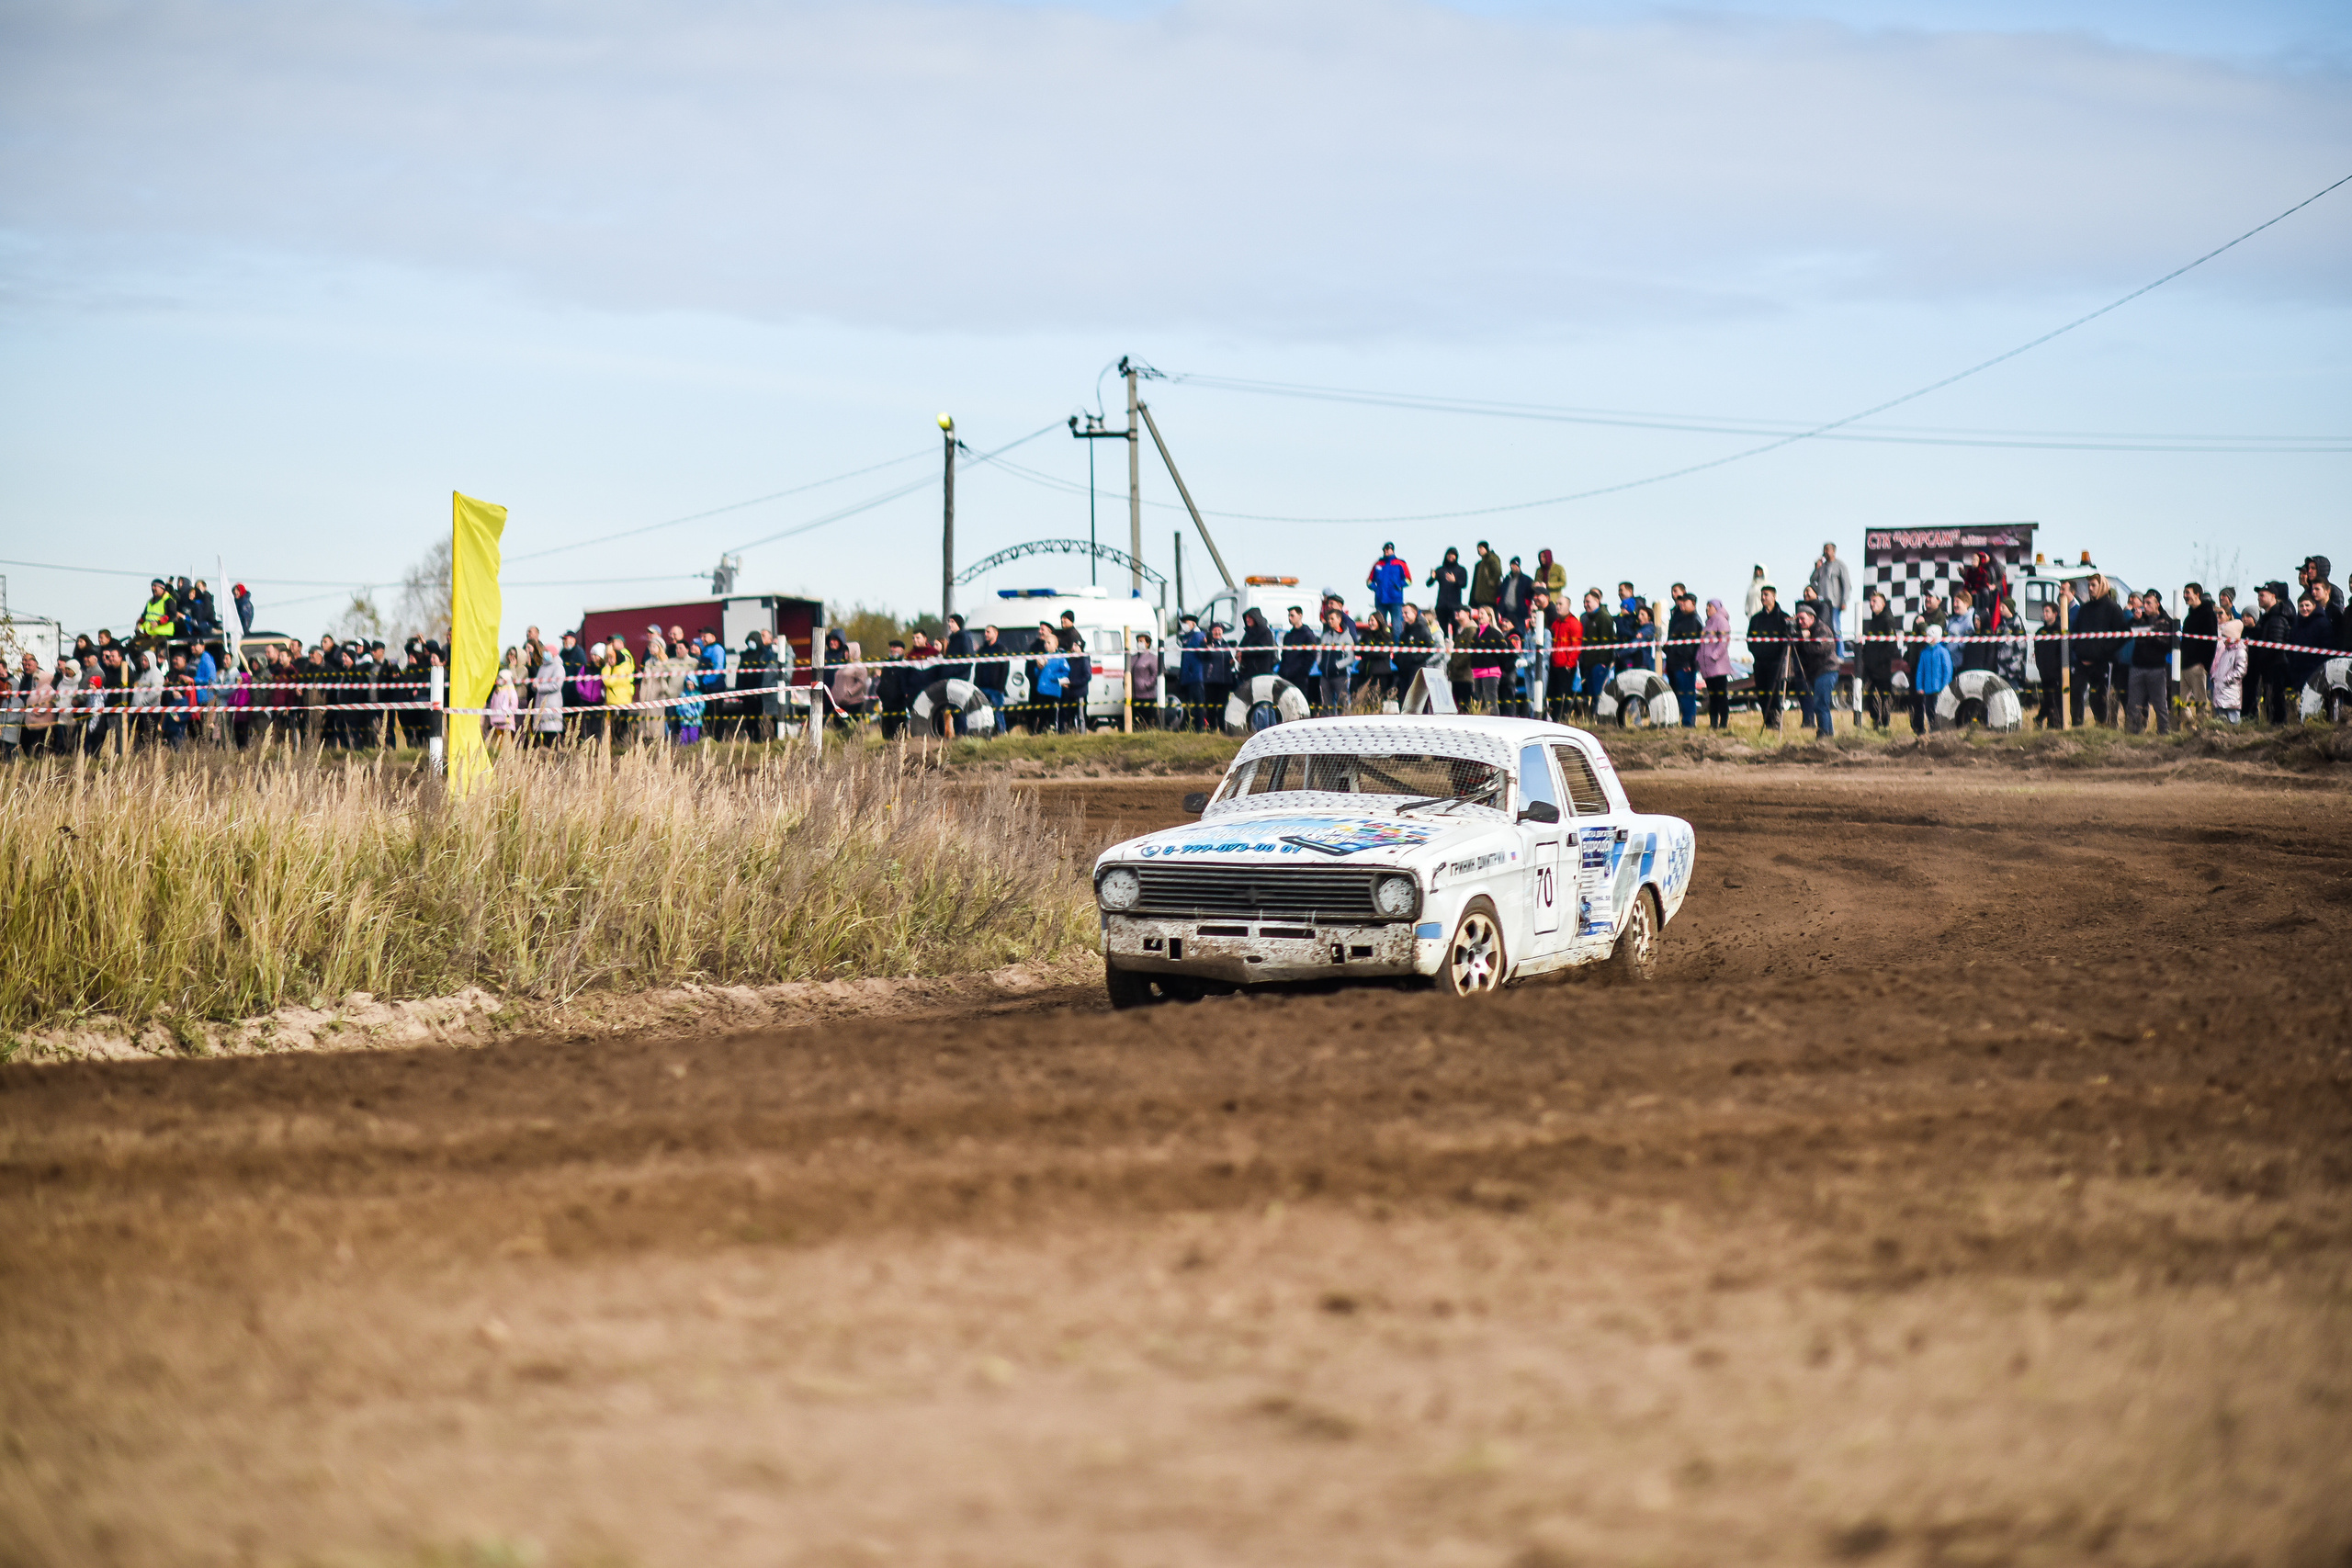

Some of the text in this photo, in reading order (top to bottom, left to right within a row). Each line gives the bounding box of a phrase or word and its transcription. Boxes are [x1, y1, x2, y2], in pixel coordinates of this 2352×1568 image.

[1867, 531, 1892, 549] СТК
[1429, 677, 1450, 706] 70
[1537, 866, 1553, 908] 70
